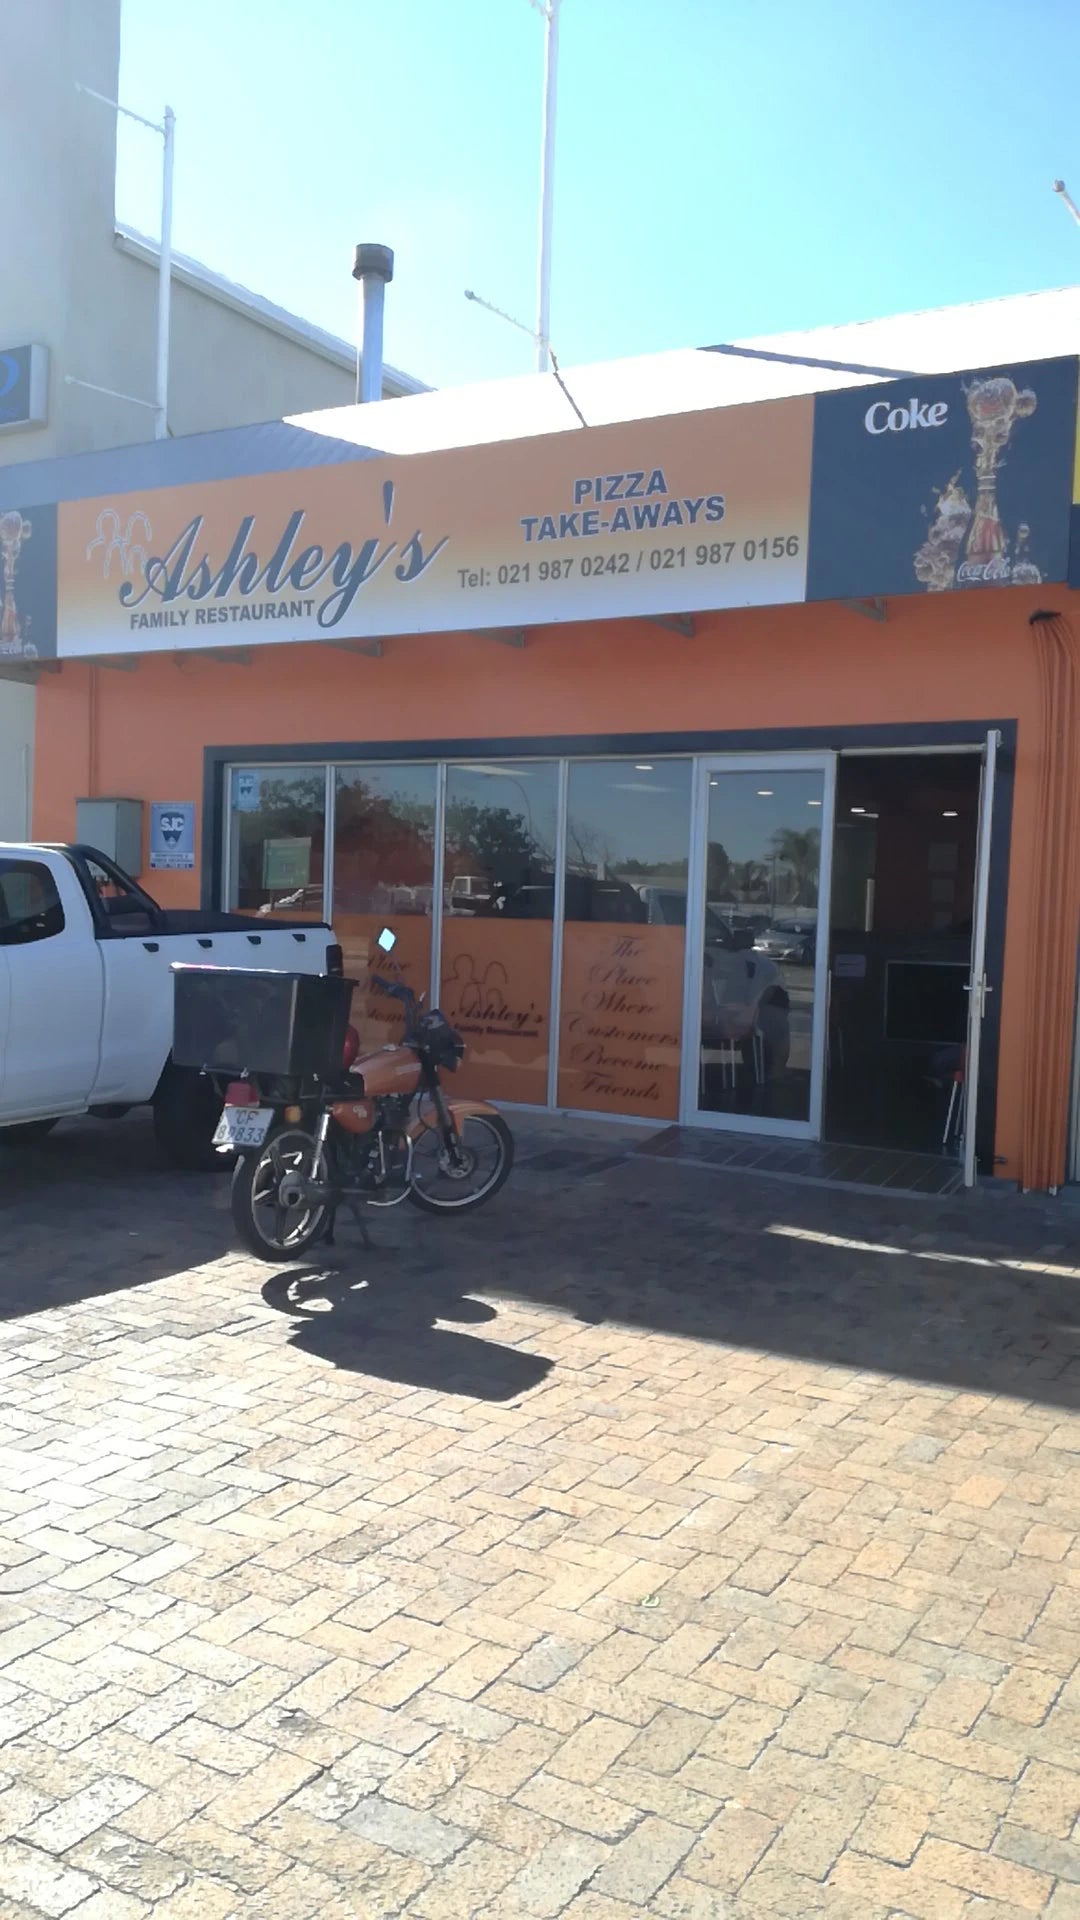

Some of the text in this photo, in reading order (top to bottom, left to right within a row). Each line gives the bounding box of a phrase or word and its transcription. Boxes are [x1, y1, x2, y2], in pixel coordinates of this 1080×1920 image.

[865, 398, 948, 434] Coke
[574, 469, 668, 504] PIZZA
[520, 495, 725, 543] TAKE-AWAYS
[119, 480, 449, 628] Ashley's
[458, 536, 799, 588] Tel: 021 987 0242 / 021 987 0156
[130, 599, 315, 630] FAMILY RESTAURANT
